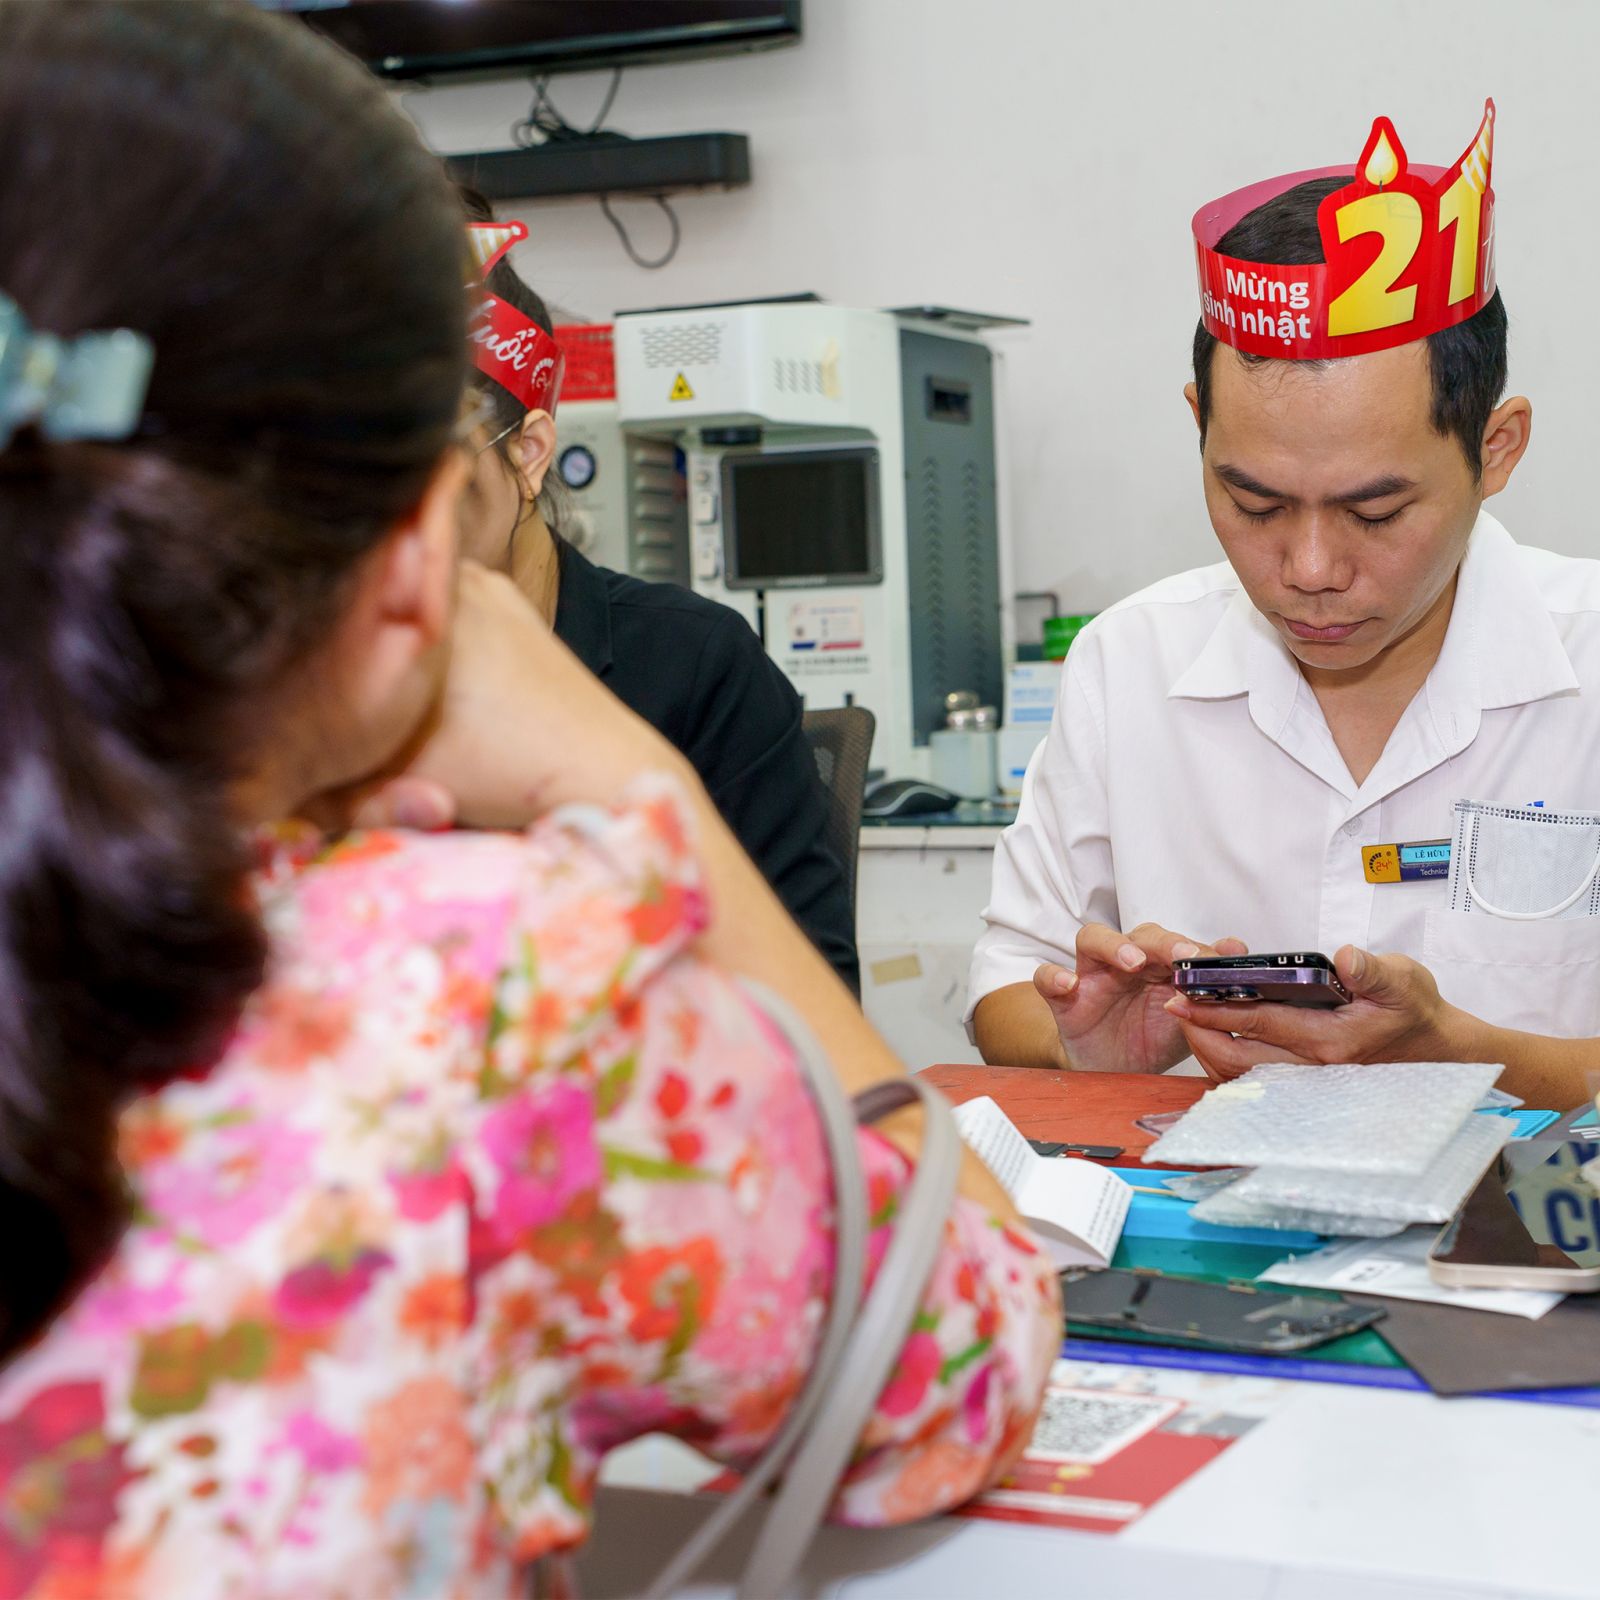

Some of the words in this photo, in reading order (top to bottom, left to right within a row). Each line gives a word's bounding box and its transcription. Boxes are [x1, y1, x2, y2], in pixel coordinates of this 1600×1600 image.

[1327, 172, 1482, 337] 21
[1225, 267, 1311, 310] Mừng
[1202, 289, 1237, 329] sinh
[1241, 308, 1312, 346] nhật
